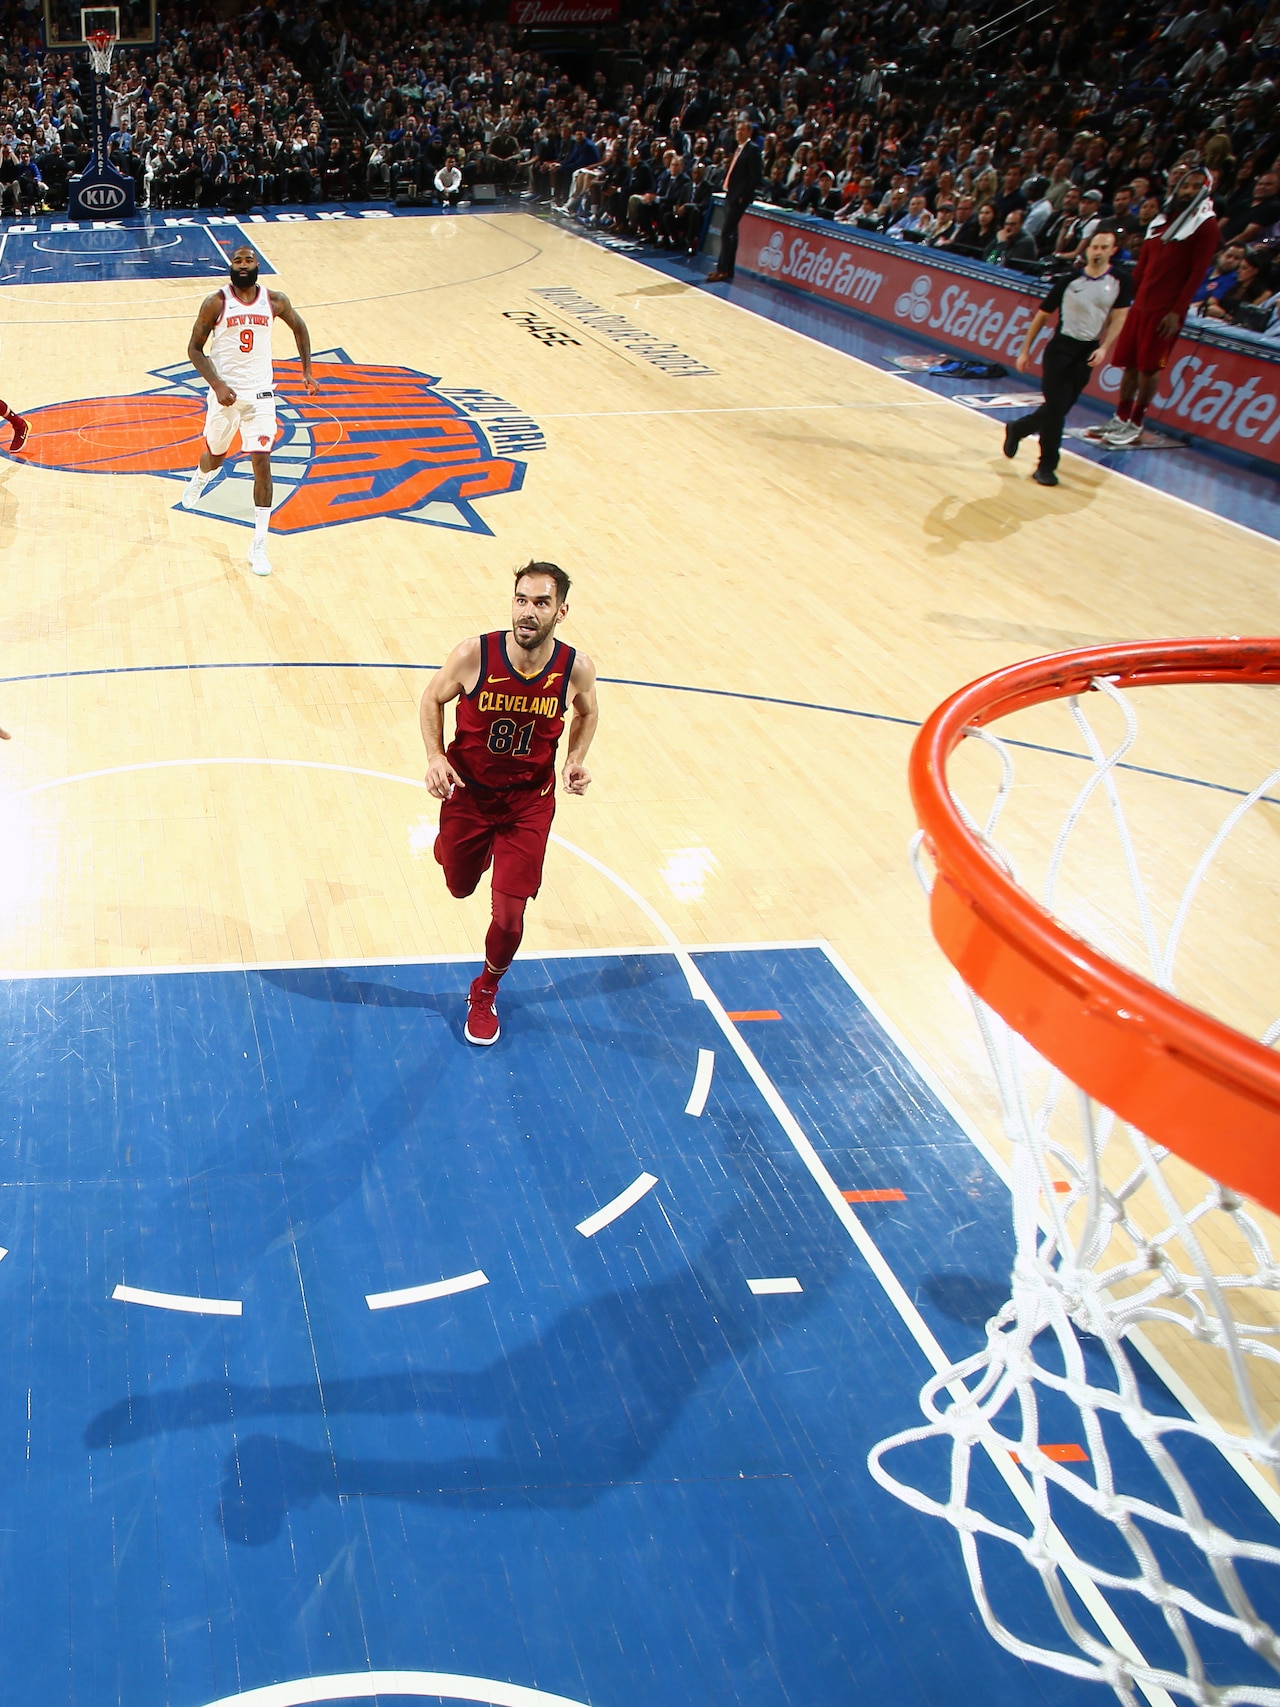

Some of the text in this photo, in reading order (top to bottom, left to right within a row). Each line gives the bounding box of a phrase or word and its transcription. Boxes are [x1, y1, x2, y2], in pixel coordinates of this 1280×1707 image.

[516, 0, 612, 24] Budweiser
[95, 84, 104, 176] Foot Locker
[86, 189, 119, 205] KIA
[163, 209, 395, 227] KNICKS
[226, 314, 269, 328] NEW YORK
[501, 310, 584, 347] CHASE
[528, 286, 721, 377] MADISON SQUARE GARDEN
[239, 329, 254, 353] 9
[434, 387, 547, 455] NEW YORK
[477, 690, 560, 719] CLEVELAND
[486, 717, 537, 757] 81
